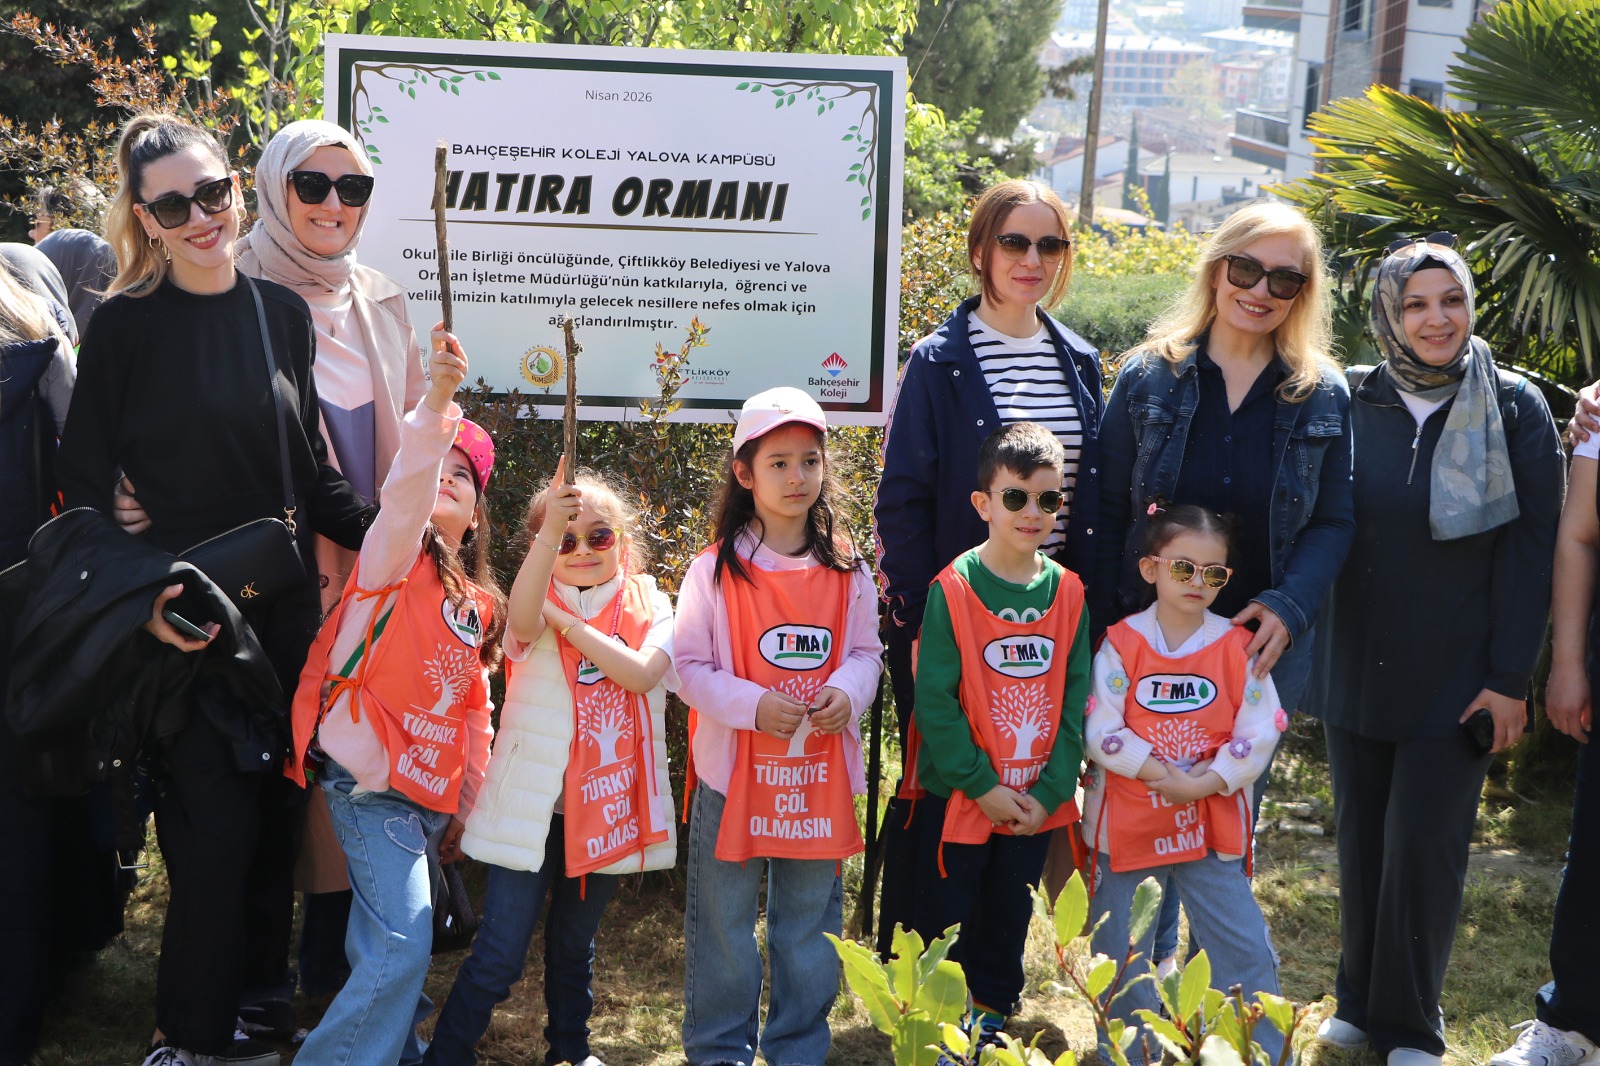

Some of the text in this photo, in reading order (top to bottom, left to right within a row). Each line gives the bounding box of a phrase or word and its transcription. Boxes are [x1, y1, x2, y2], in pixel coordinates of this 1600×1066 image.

[585, 89, 653, 103] Nisan 2026
[452, 143, 776, 167] BAHÇEŞEHİR KOLEJİ YALOVA KAMPÜSÜ
[612, 176, 789, 223] ORMANI
[402, 248, 436, 260] Okul
[472, 250, 513, 266] Birliği
[517, 251, 614, 268] öncülüğünde,
[618, 255, 686, 271] Çiftlikköy
[690, 258, 761, 273] Belediyesi
[765, 262, 781, 272] ve
[785, 261, 831, 273] Yalova
[418, 269, 468, 282] Oran
[473, 269, 526, 286] İşletme
[643, 276, 728, 293] katkılarıyla,
[735, 279, 787, 294] öğrenci
[791, 283, 807, 293] ve
[408, 290, 816, 316] velileimizin katılımıyla gelecek nesillere nefes olmak için
[548, 314, 678, 332] ağçlandırılmıştır.
[808, 377, 860, 388] Bahçeşehir
[820, 388, 847, 399] Koleji
[777, 632, 820, 652] TEMA
[1001, 642, 1039, 662] TEMA
[1151, 680, 1196, 700] TEMA
[581, 762, 637, 805] TÜRKİY
[754, 760, 828, 787] TÜRKİYE
[775, 788, 808, 818] ÇÖL
[750, 815, 832, 839] OLMASIN
[1175, 800, 1199, 832] ÇÖ
[587, 816, 639, 859] OLMAS
